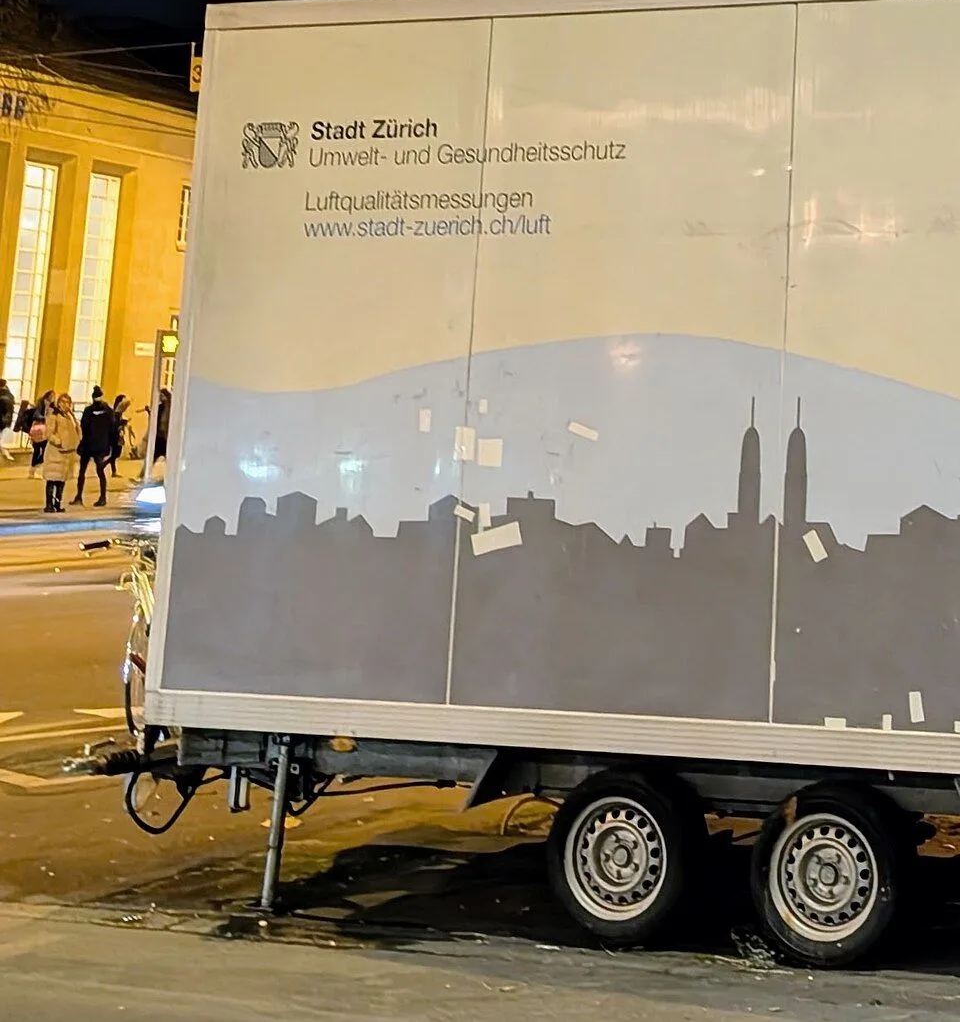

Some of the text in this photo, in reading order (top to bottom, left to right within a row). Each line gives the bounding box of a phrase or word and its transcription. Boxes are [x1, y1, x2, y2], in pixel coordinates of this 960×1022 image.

[310, 117, 439, 141] Stadt Zürich
[308, 140, 627, 168] Umwelt- und Gesundheitsschutz
[304, 190, 533, 215] Luftqualitätsmessungen
[303, 213, 552, 238] www.stadt-zuerich.ch/luft
